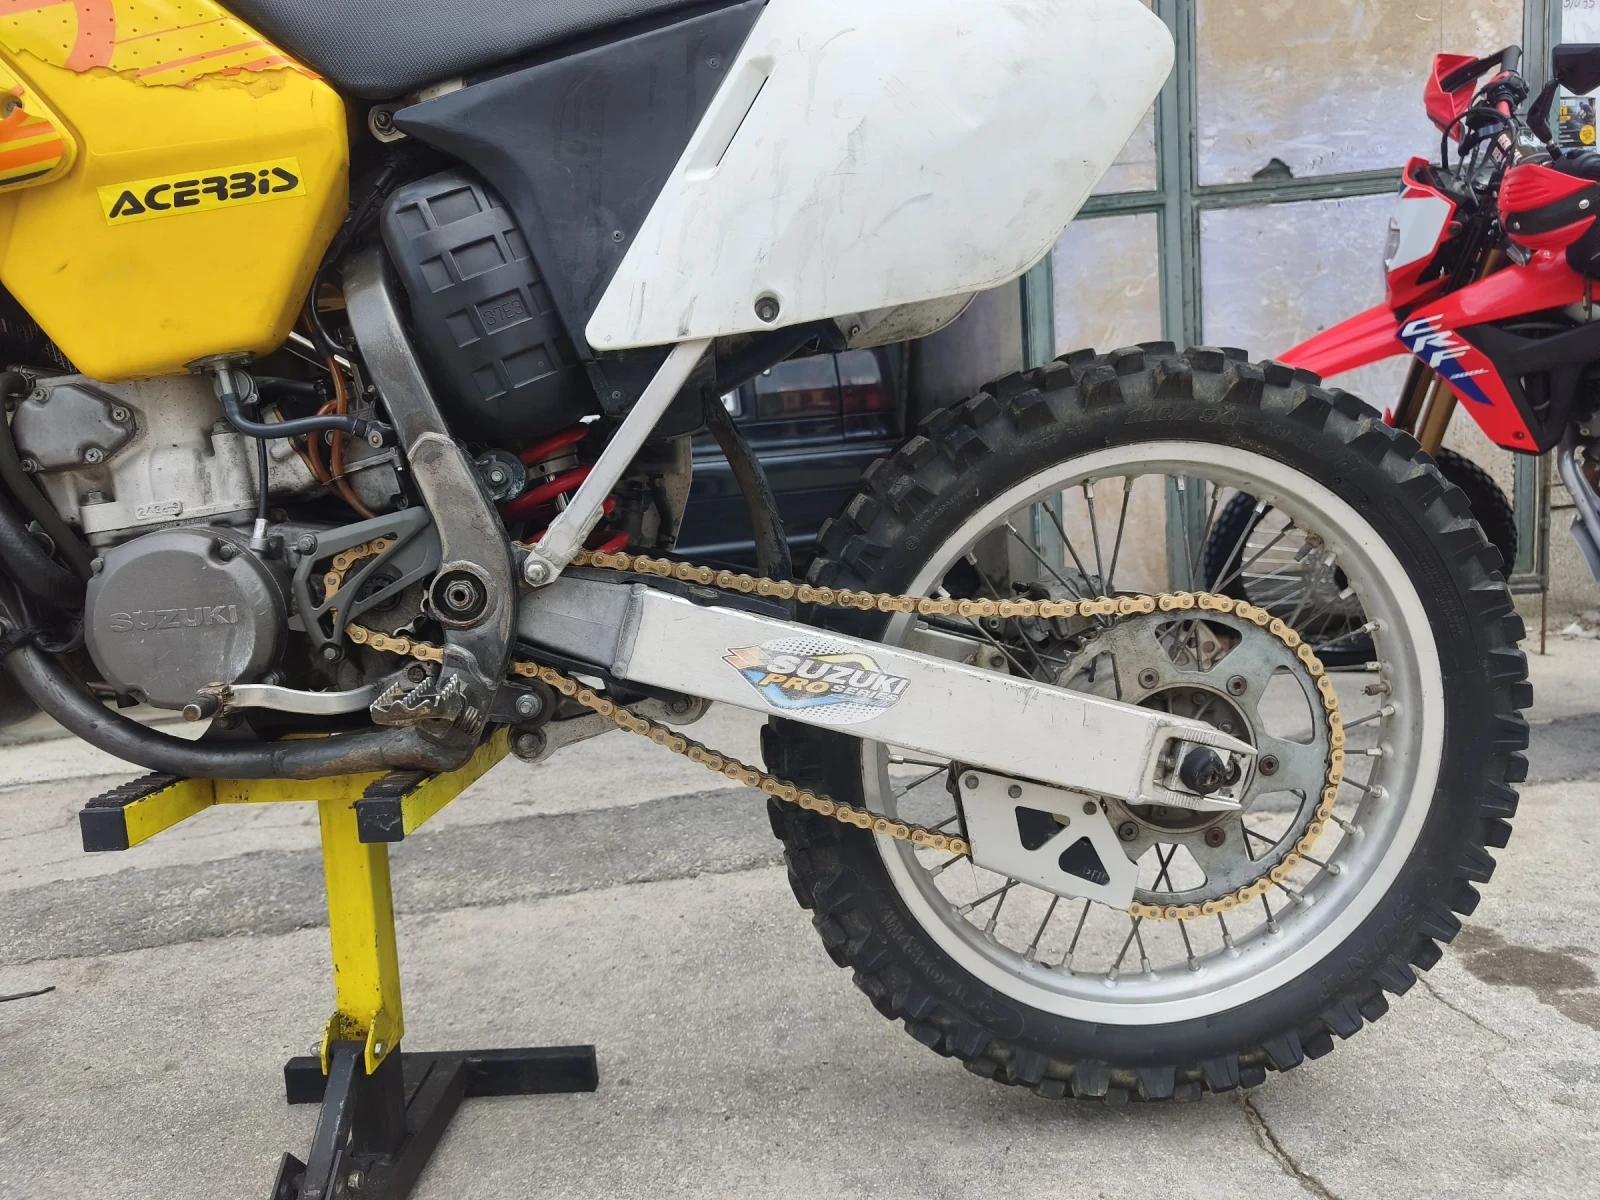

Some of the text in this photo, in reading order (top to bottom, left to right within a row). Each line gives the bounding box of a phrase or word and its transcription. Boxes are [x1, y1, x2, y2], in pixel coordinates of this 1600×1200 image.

[1401, 313, 1471, 368] CRF
[109, 604, 239, 633] SUZUKI
[758, 672, 901, 703] PRO SERIES
[765, 654, 909, 695] SUZUKI
